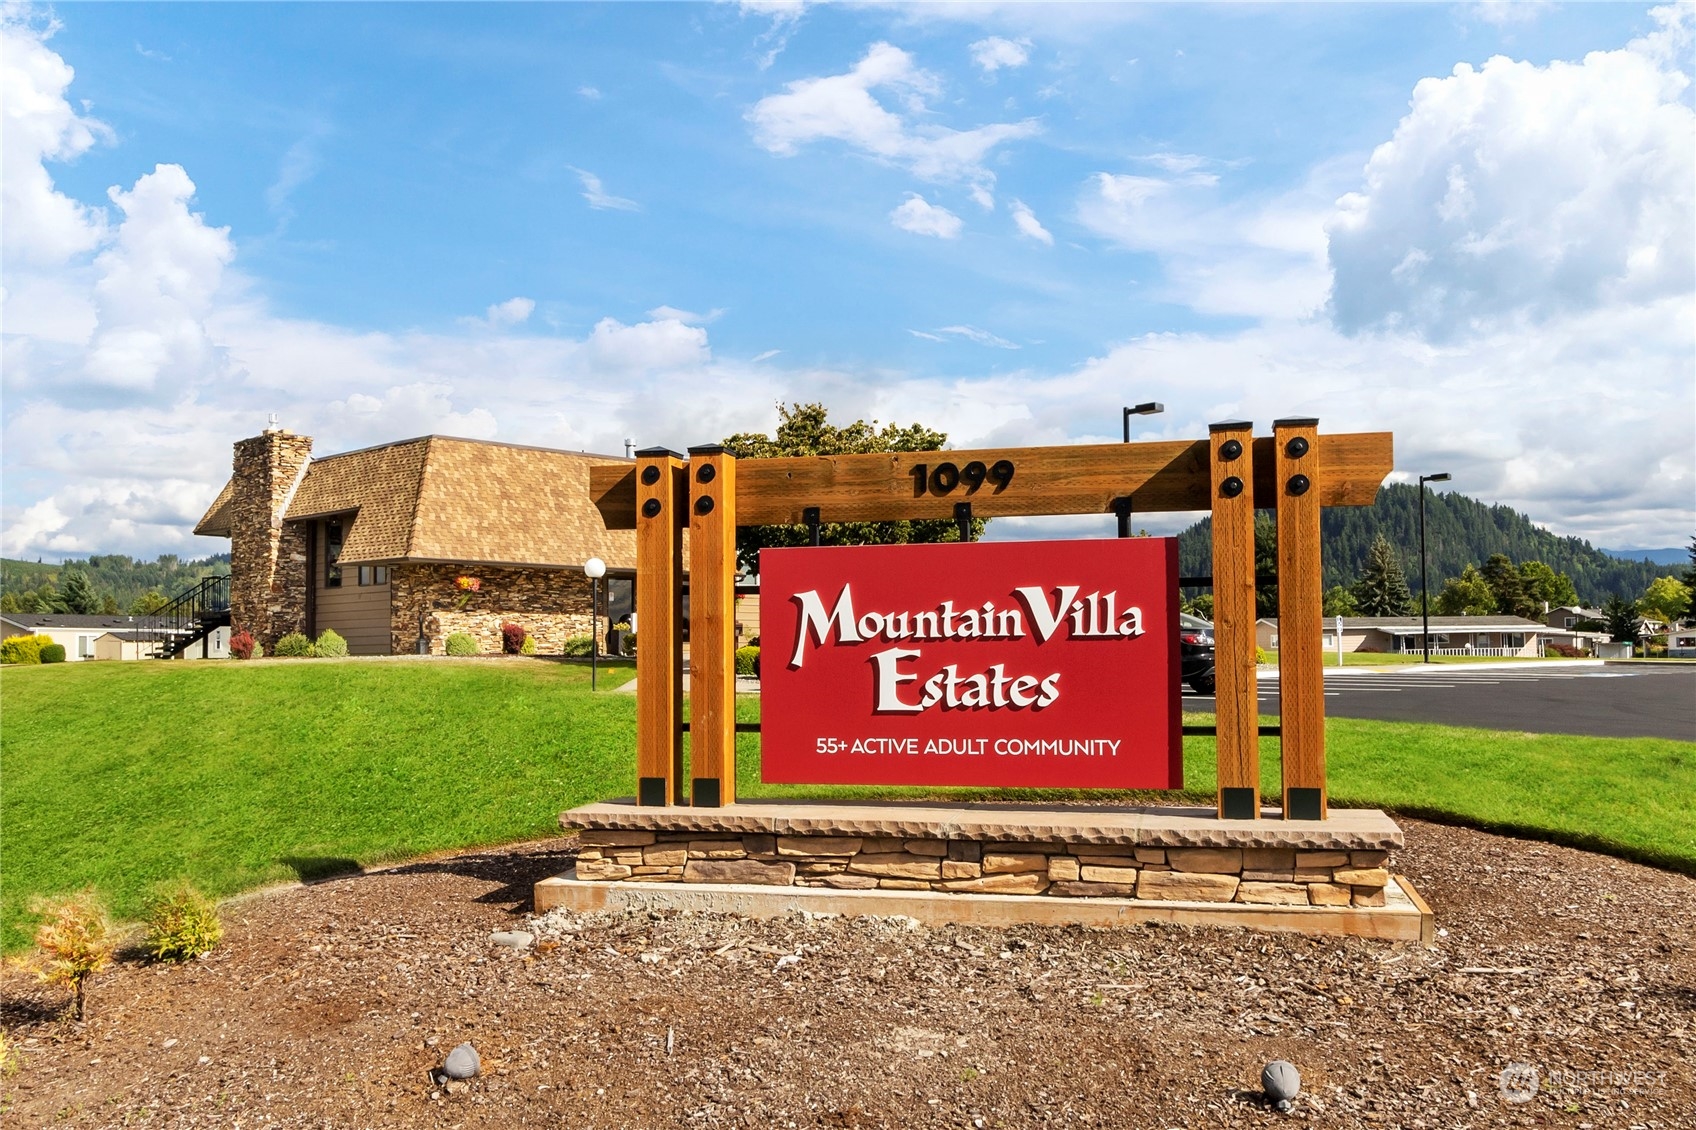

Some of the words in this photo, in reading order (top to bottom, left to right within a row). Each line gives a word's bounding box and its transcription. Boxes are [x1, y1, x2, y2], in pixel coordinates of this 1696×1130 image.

[908, 459, 1015, 498] 1099
[869, 646, 1061, 712] Estates
[815, 737, 849, 755] 55+
[851, 737, 919, 755] ACTIVE
[923, 738, 989, 756] ADULT
[994, 738, 1122, 757] COMMUNITY
